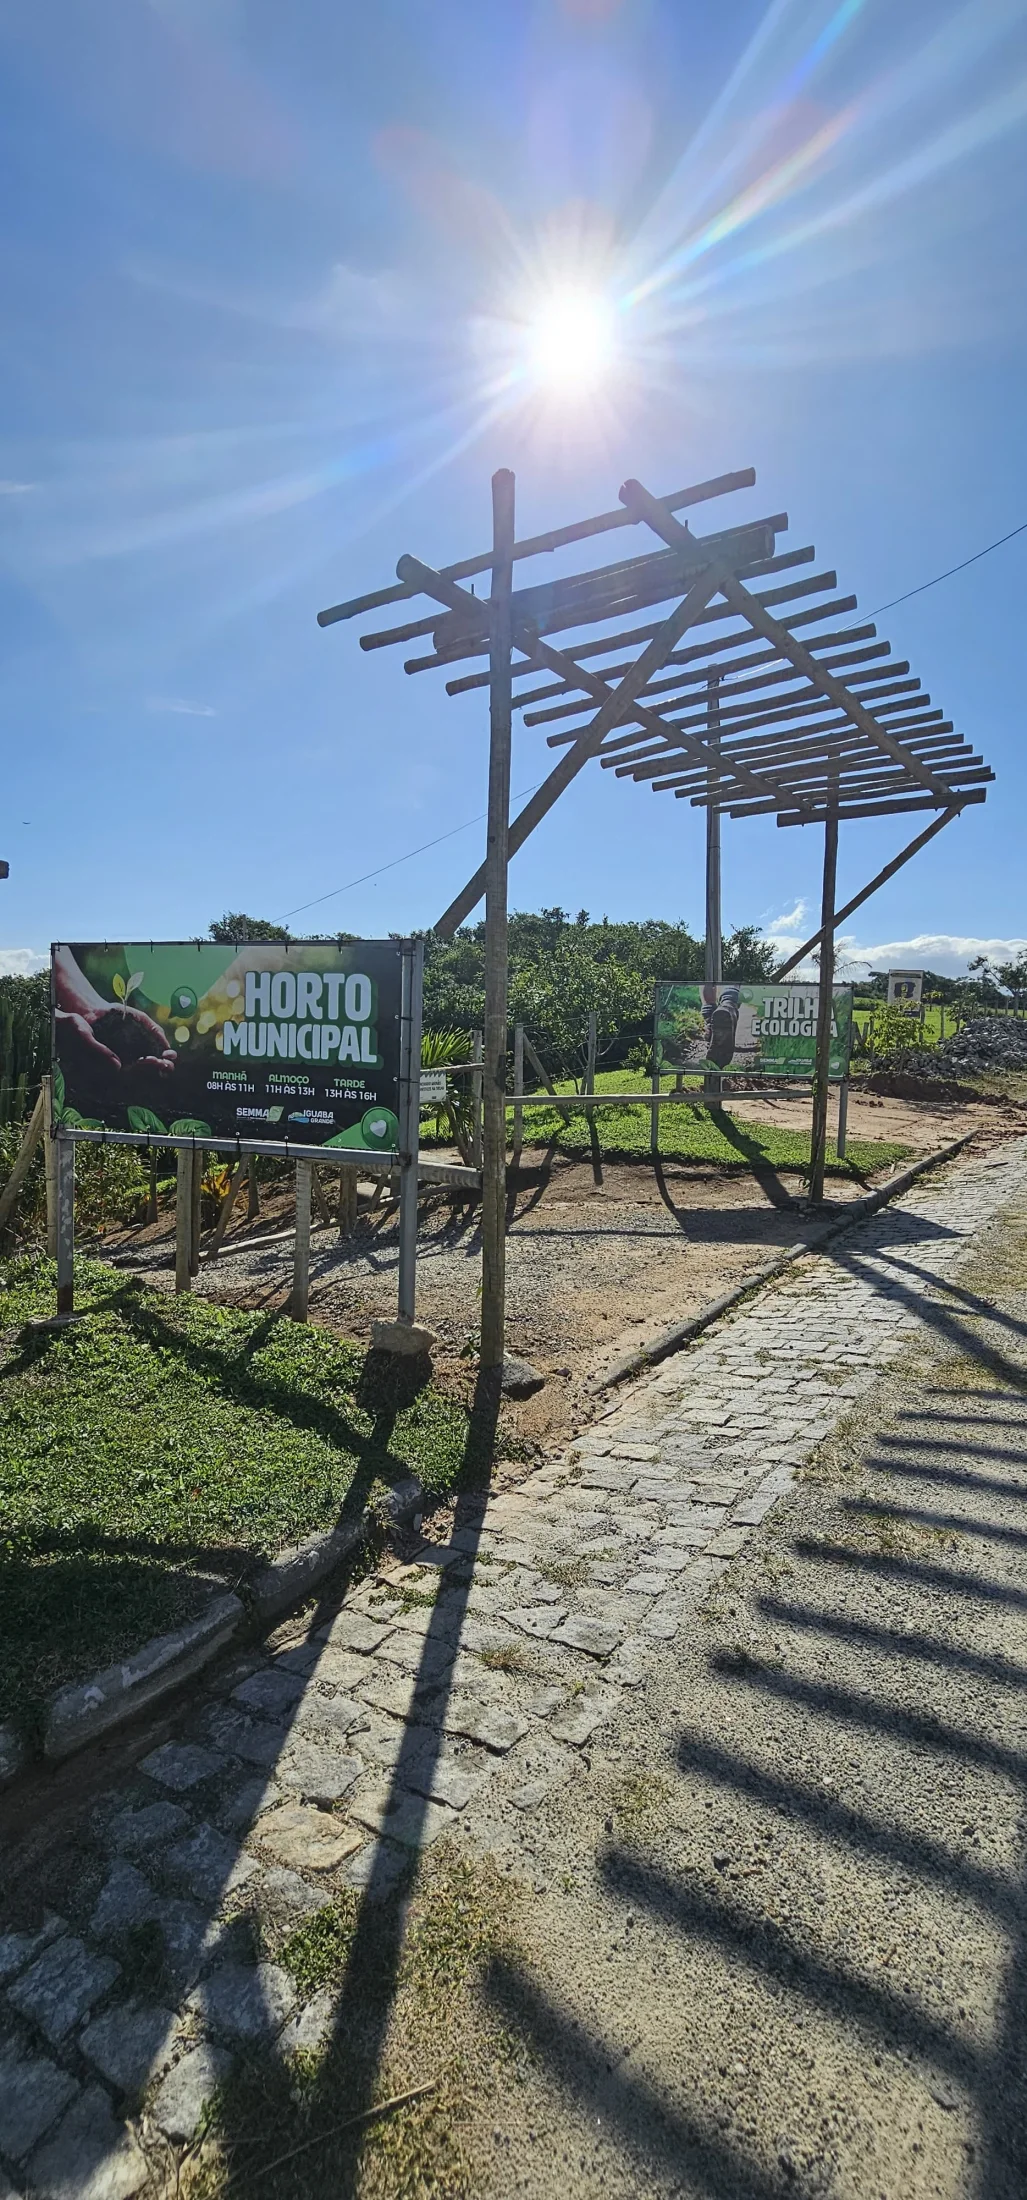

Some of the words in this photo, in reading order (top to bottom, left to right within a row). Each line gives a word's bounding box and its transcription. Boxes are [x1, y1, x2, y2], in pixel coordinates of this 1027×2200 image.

[245, 971, 372, 1021] HORTO
[762, 997, 835, 1019] TRILH
[751, 1017, 838, 1038] ECOLÓGIA
[223, 1021, 378, 1063] MUNICIPAL
[206, 1081, 223, 1090] 08H
[224, 1080, 237, 1091] ÀS
[238, 1083, 255, 1092] 11H
[268, 1073, 310, 1086] ALMOÇO
[333, 1078, 366, 1088] TARDE
[265, 1084, 282, 1093] 11H
[283, 1084, 296, 1094] ÀS
[298, 1086, 315, 1095] 13H
[324, 1088, 343, 1098] 13H
[344, 1088, 358, 1099] ÀS
[358, 1091, 377, 1101] 16H
[236, 1107, 270, 1117] SEMMA
[303, 1109, 334, 1119] IGUABA
